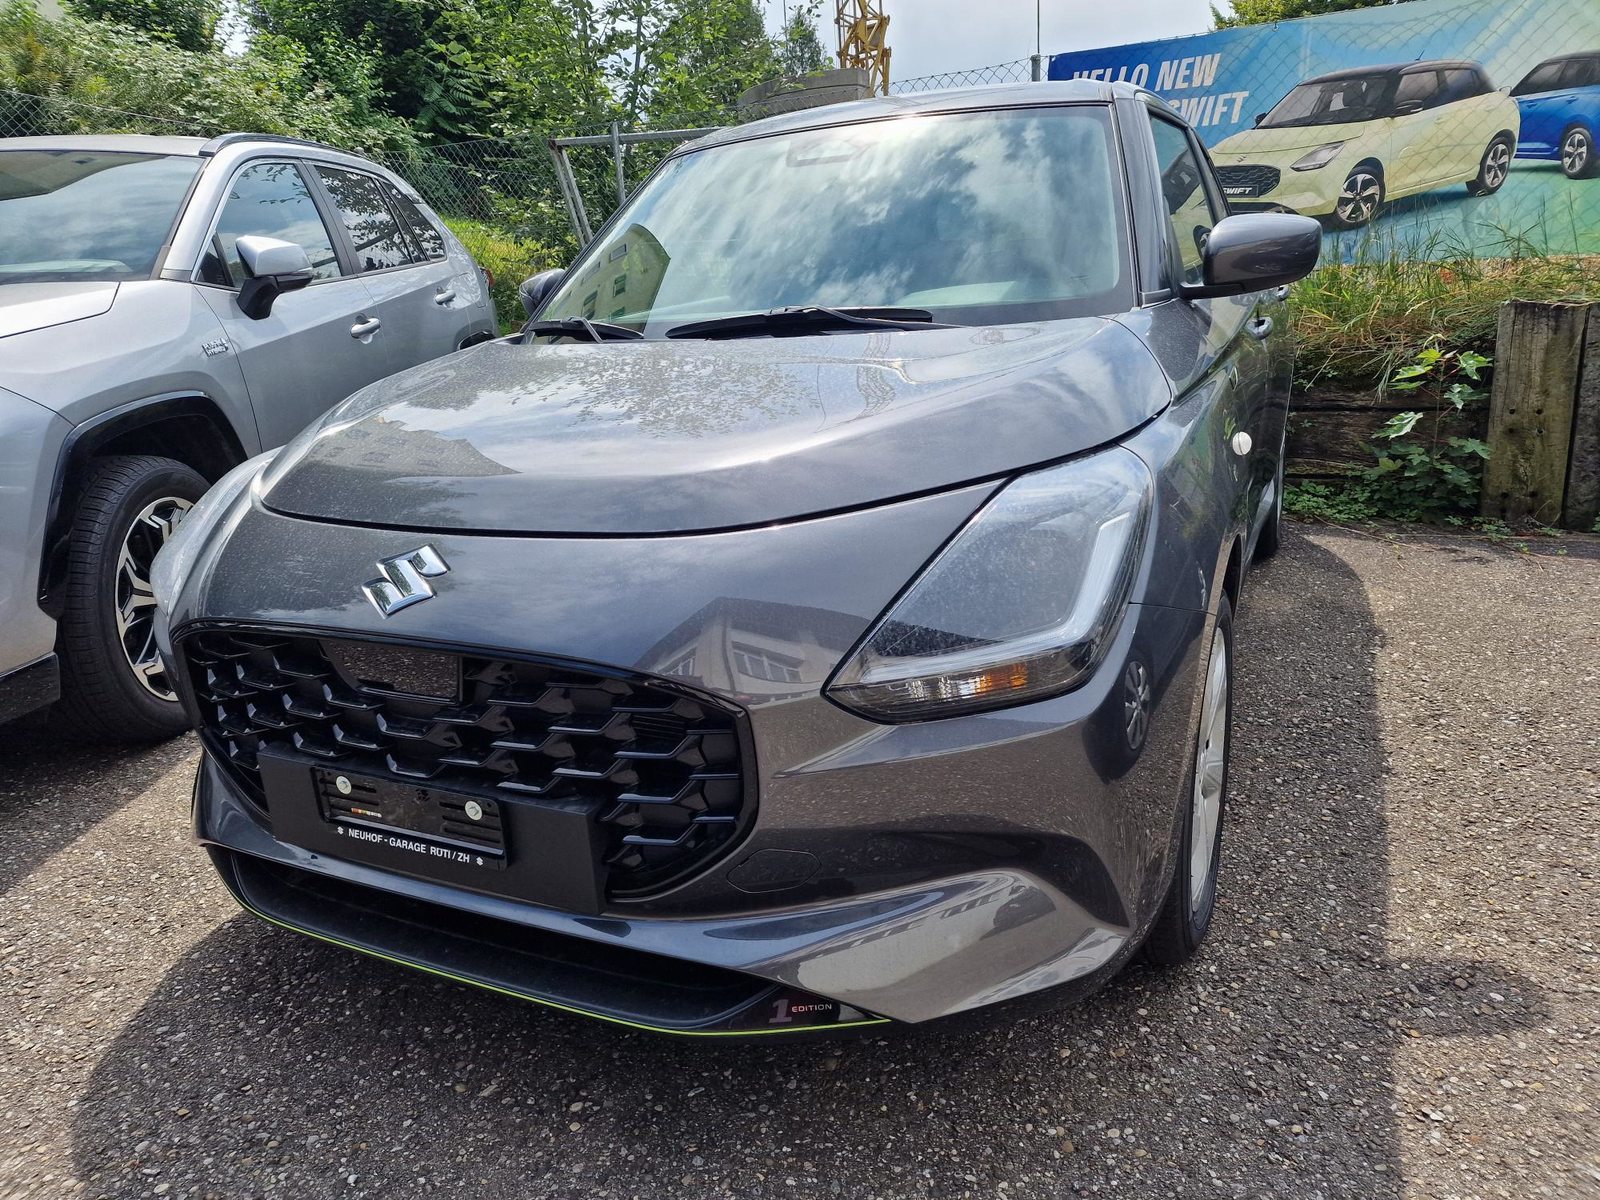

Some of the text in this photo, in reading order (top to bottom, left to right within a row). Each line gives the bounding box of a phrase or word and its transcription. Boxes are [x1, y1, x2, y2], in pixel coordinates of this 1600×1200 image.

[1154, 53, 1221, 92] NEW
[348, 828, 383, 844] NEUHOF
[389, 837, 426, 854] GARAGE
[768, 999, 832, 1023] 1 EDITION
